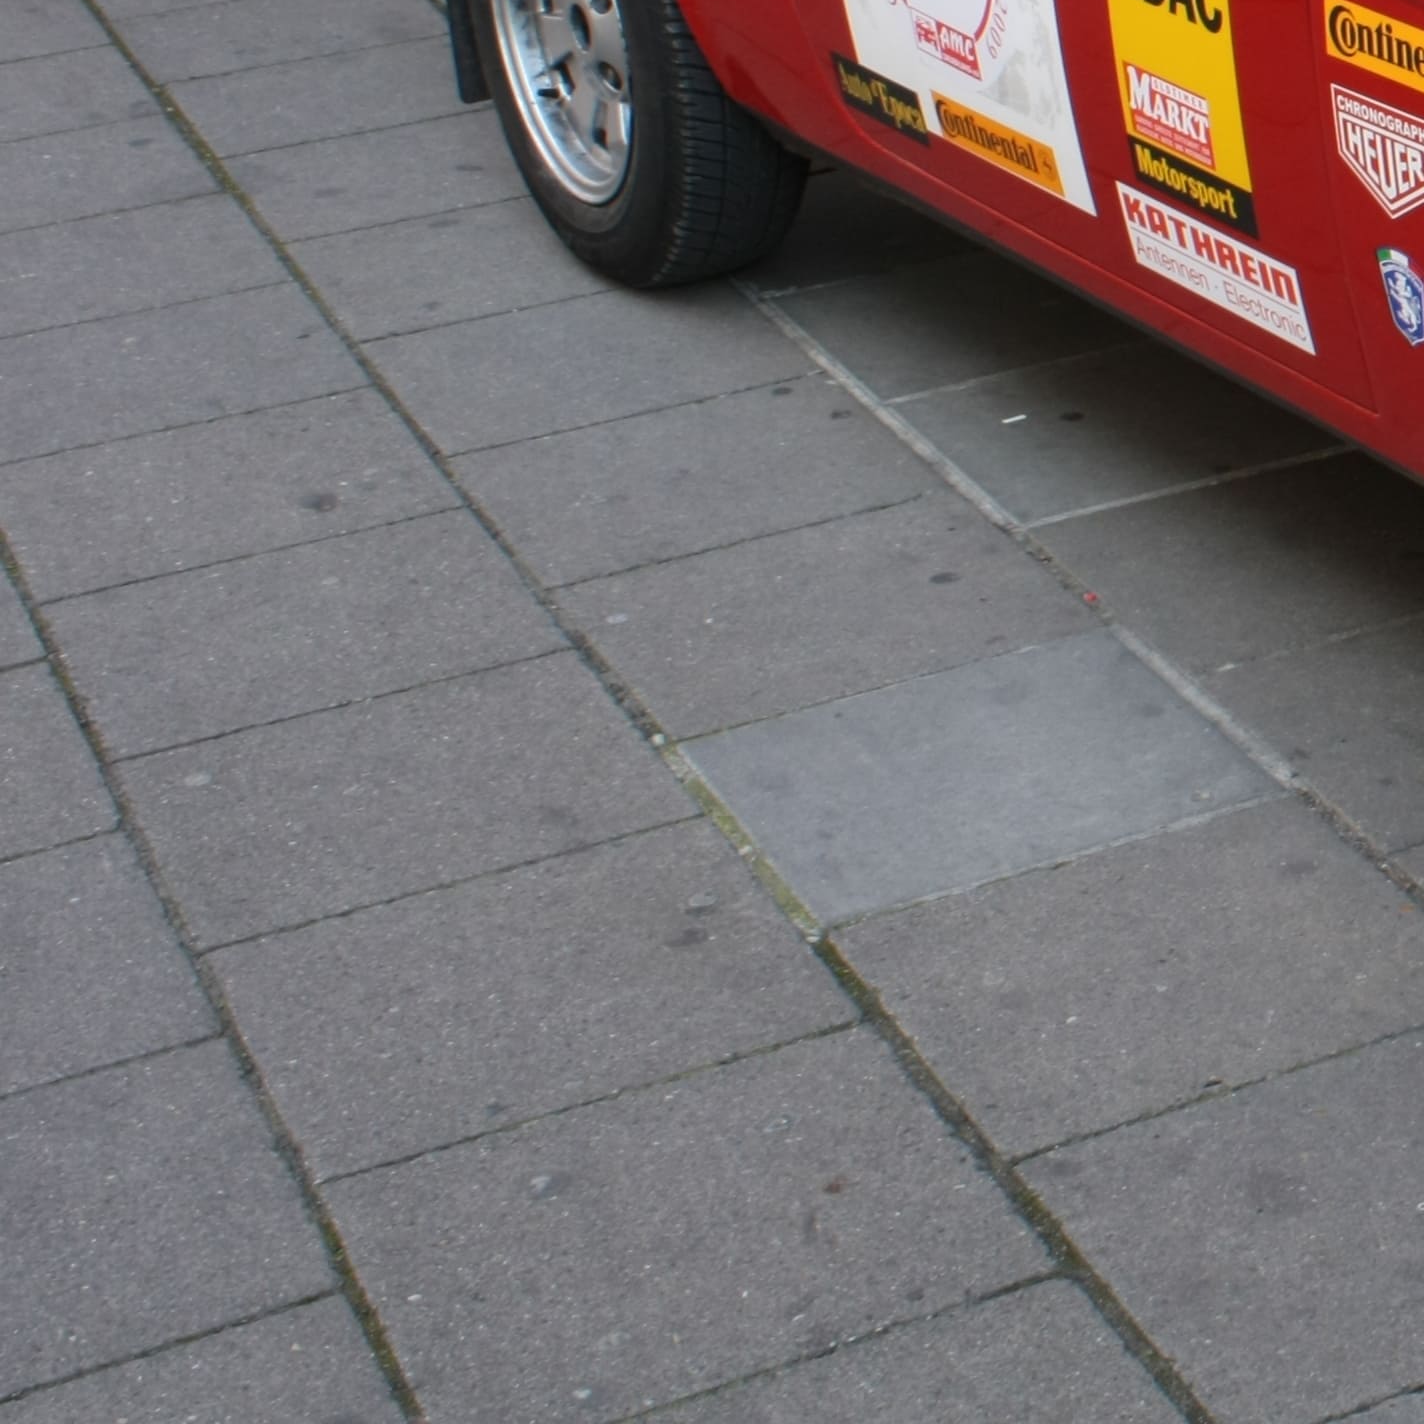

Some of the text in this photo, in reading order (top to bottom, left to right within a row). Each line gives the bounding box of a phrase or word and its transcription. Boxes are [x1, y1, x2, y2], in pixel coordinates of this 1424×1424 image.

[939, 26, 976, 62] AMC
[935, 99, 1040, 175] Continental
[1134, 142, 1238, 221] Motorsport
[1121, 191, 1298, 307] KATHREIN
[1136, 235, 1211, 293] Antennen
[1224, 279, 1308, 343] Electronic
